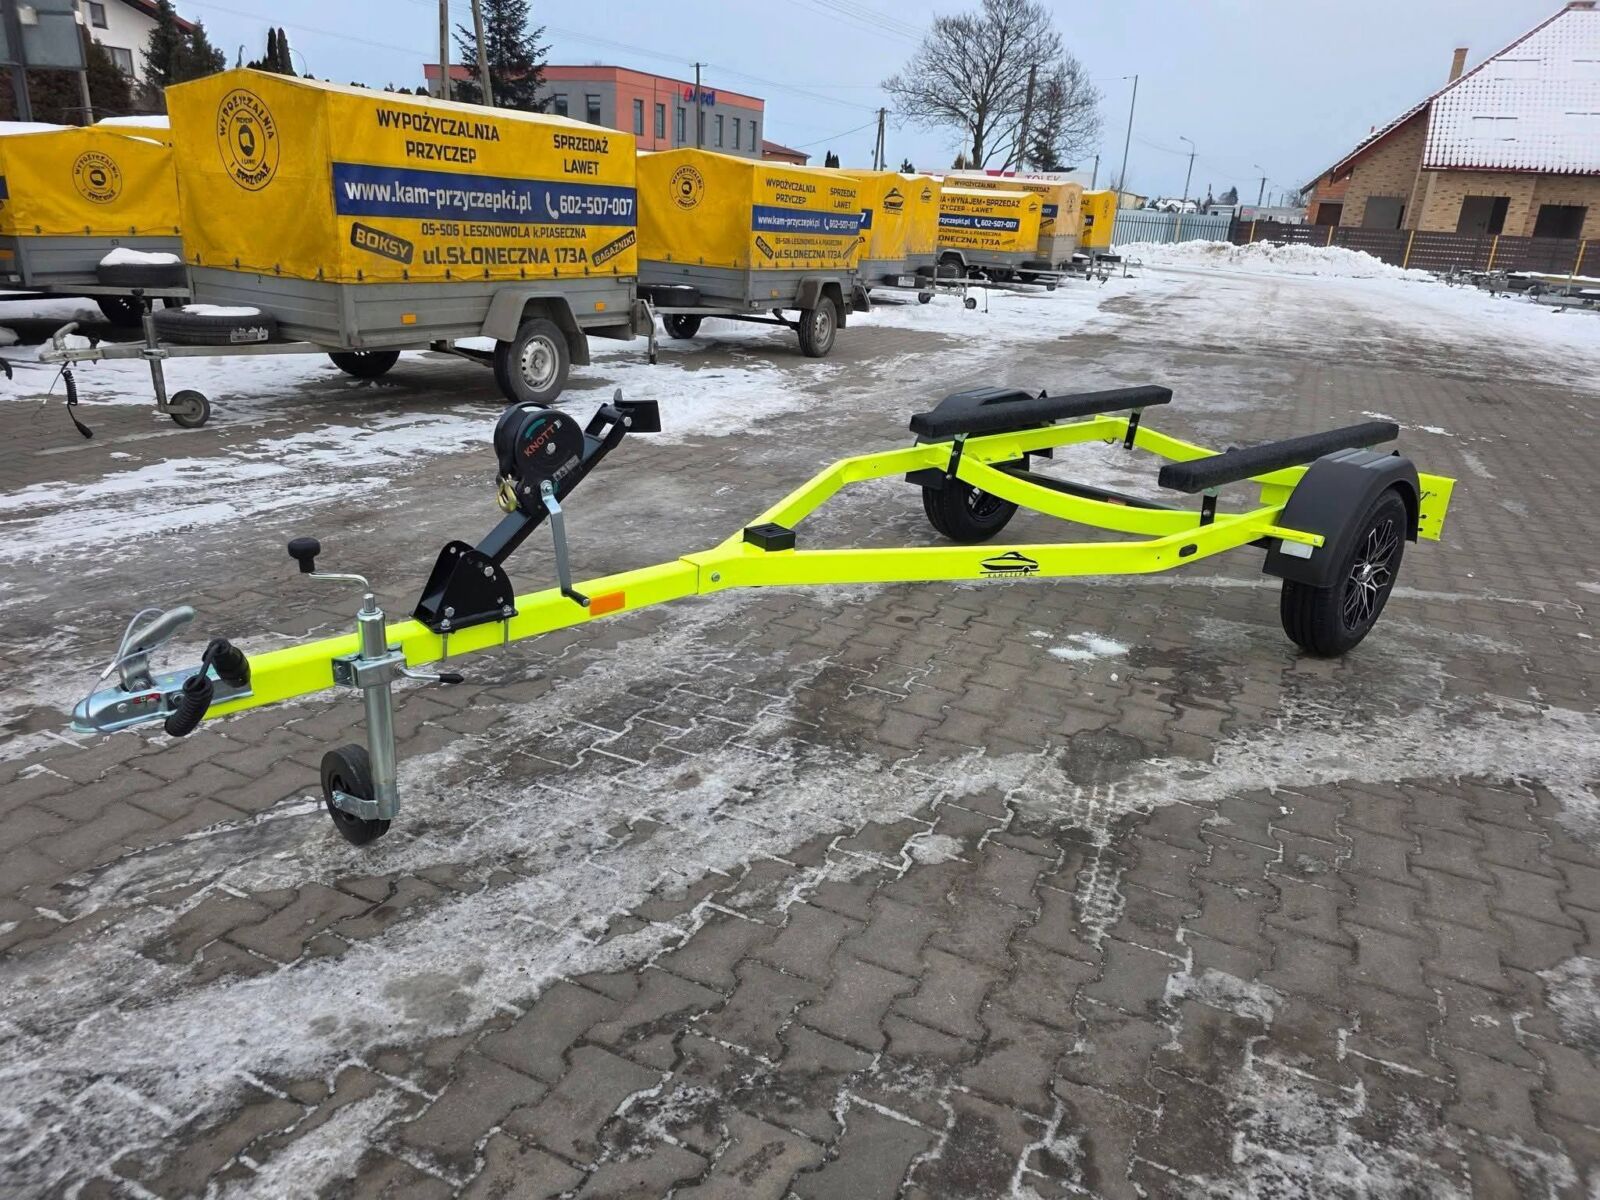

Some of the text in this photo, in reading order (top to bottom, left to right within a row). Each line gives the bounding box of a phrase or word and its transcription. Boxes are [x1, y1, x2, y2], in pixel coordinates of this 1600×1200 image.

[219, 95, 275, 140] WYPOŻYCZALNIA
[375, 108, 501, 142] WYPOŻYCZALNIA
[405, 140, 477, 164] PRZYCZEP
[553, 133, 609, 154] SPRZEDAŻ
[563, 158, 600, 175] LAWET
[765, 178, 817, 194] WYPOŻYCZALNIA
[344, 181, 533, 215] www.kam-przyczepki.pl
[560, 195, 633, 216] 602-507-007
[775, 192, 807, 205] PRZYCZEP
[833, 200, 852, 209] LAWET
[951, 197, 982, 206] WYNAJEM
[421, 222, 587, 239] 05-506 LESZNOWOLA k.PIASECZNA
[980, 219, 1018, 229] 602-507-007
[356, 228, 409, 260] BOKSY
[593, 233, 635, 265] BAGAŻNIKI
[980, 238, 1001, 246] 173A
[423, 246, 588, 265] ul.SŁONECZNA 173A
[523, 425, 555, 457] KNOTT
